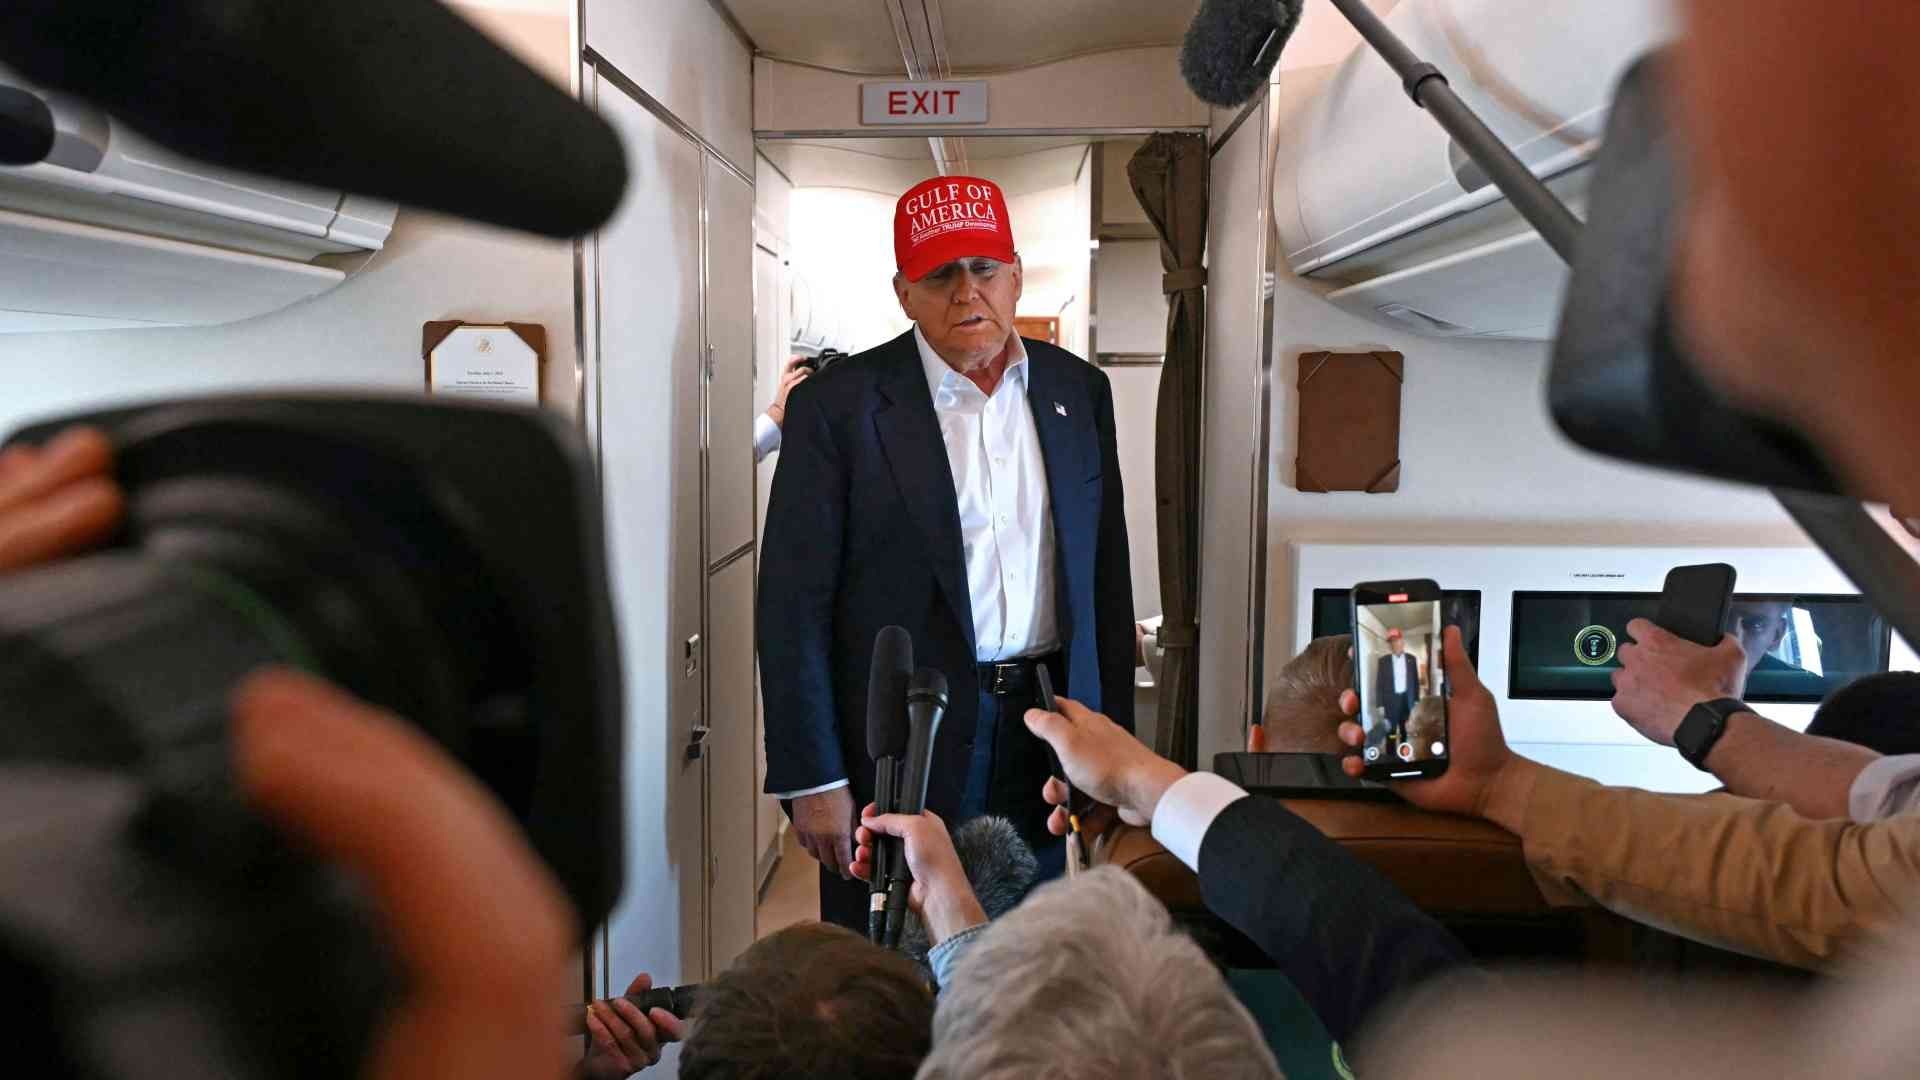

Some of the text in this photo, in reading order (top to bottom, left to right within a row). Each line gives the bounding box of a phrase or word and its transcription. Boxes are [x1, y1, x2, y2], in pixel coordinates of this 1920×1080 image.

[888, 90, 960, 115] EXIT
[905, 183, 992, 215] GULF OF
[911, 202, 996, 235] AMERICA
